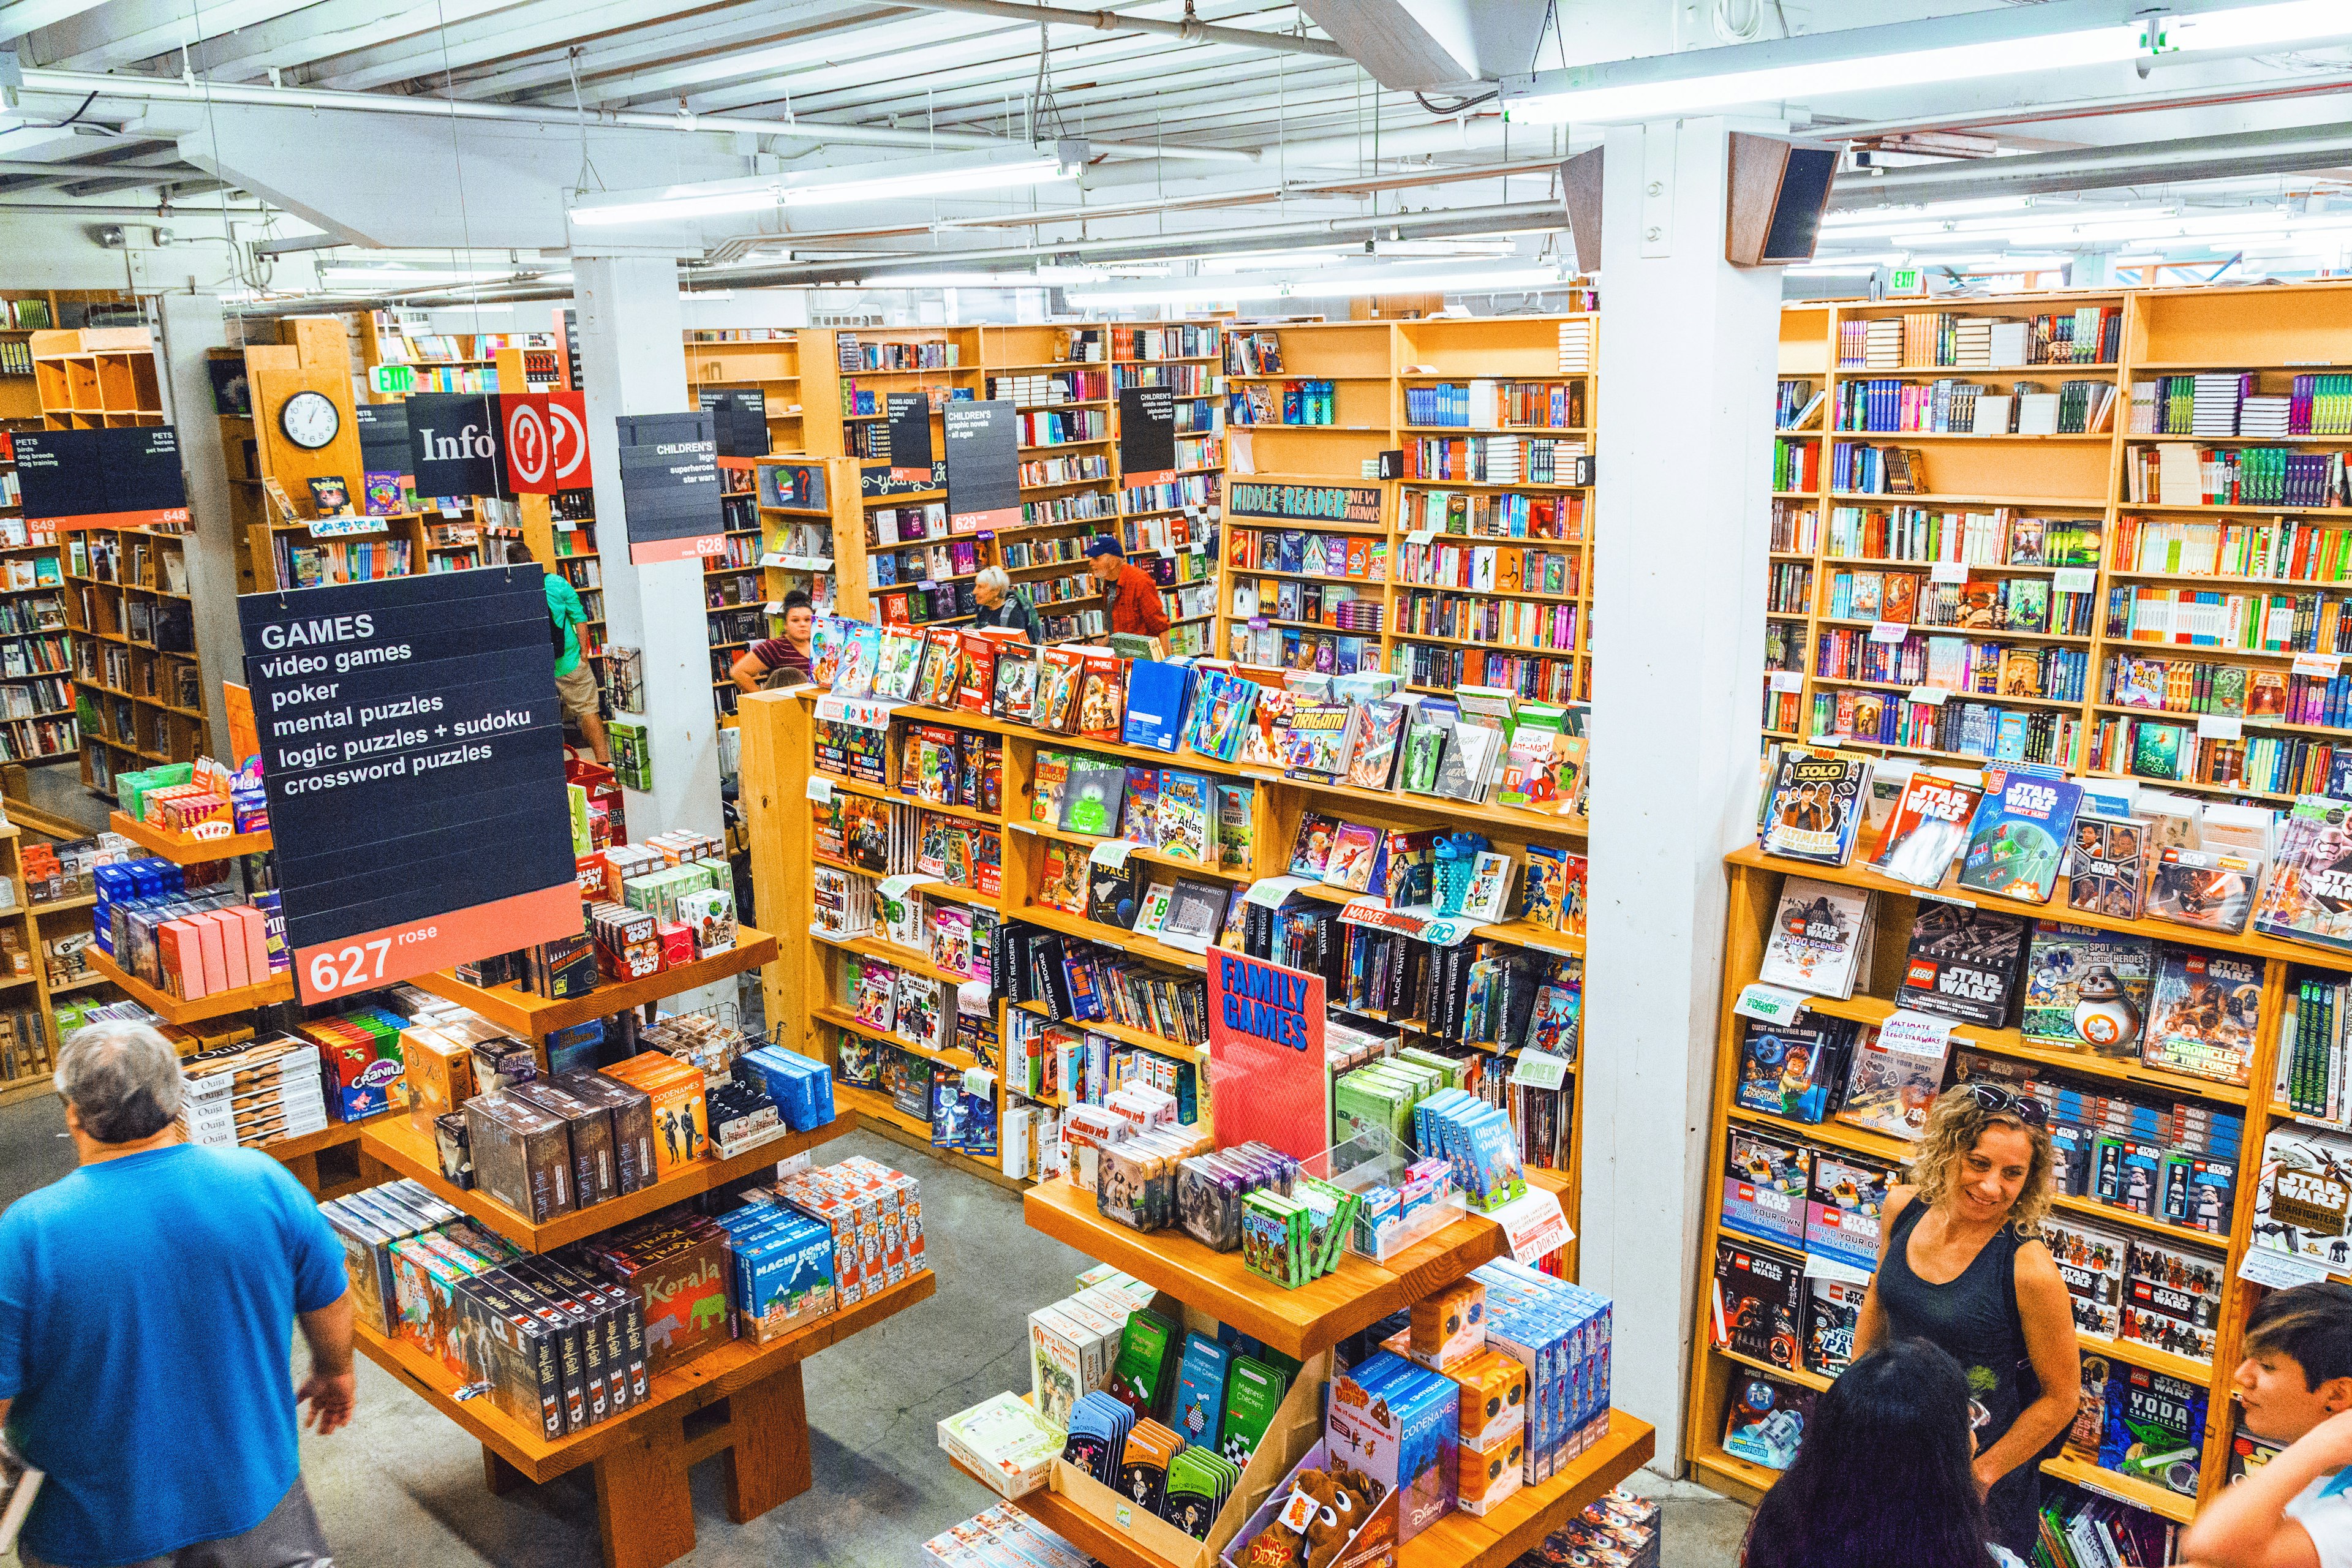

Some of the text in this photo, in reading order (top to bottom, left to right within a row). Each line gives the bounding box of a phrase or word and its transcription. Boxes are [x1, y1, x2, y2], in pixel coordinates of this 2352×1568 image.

[1895, 271, 1916, 288] EXIT
[379, 368, 409, 391] EXIT
[948, 411, 991, 421] CHILDREN'S
[948, 421, 969, 430] graphic
[420, 424, 496, 461] Info
[657, 442, 713, 455] CHILDREN'S
[670, 464, 715, 474] superheroes
[891, 470, 903, 479] 640
[1381, 456, 1390, 477] A
[1577, 459, 1586, 483] B
[1159, 472, 1174, 483] 630
[1232, 484, 1279, 513] MIDDLE
[1350, 489, 1376, 505] NEW
[163, 510, 187, 521] 648
[1344, 505, 1380, 521] ARRIVALS
[31, 520, 55, 531] 649
[956, 516, 976, 530] 629
[696, 538, 723, 554] 628
[262, 614, 375, 649] GAMES
[260, 642, 412, 679] video games
[271, 681, 339, 711] poker
[273, 694, 444, 737] mental puzzles
[1292, 712, 1346, 730] ORIGAMI
[279, 709, 531, 769] logic puzzles sudoku
[1512, 742, 1550, 753] Ant-Man!
[1814, 748, 1835, 761] 1000
[1836, 752, 1864, 761] STICKERS
[284, 742, 492, 795] crossword puzzles
[1072, 760, 1124, 772] UNDERWEAR!
[1799, 765, 1841, 777] SOLO
[1913, 774, 1950, 786] DARTH VADER
[1913, 785, 1969, 809] STAR
[2006, 782, 2059, 799] STAR
[1163, 797, 1196, 821] Animal
[1906, 797, 1968, 822] WARS
[2005, 794, 2056, 811] WARS
[1178, 815, 1203, 834] Atlas
[1224, 815, 1243, 824] MOVIE
[1778, 827, 1834, 845] ULTIMATE
[1104, 845, 1125, 859] NEW
[1097, 863, 1129, 878] SPACE
[2090, 867, 2117, 876] WARS
[2093, 861, 2114, 870] STAR
[2218, 859, 2247, 869] PHONICS
[1200, 885, 1224, 895] ARCHITECT
[1262, 887, 1281, 901] NEW
[1346, 907, 1385, 925] MARVEL
[625, 919, 652, 932] SUSHI
[1431, 925, 1452, 942] DC
[628, 928, 652, 943] GO!
[1790, 934, 1842, 952] 100 SCENES
[1919, 945, 2003, 967] ULTIMATE
[2089, 943, 2109, 953] SPOT
[310, 925, 438, 993] 627 rose
[2082, 953, 2144, 965] GALACTIC HEROES
[1910, 966, 1935, 981] LEGO
[1942, 967, 2002, 987] STAR
[1038, 952, 1060, 1021] CHAPTER BOOKS
[1221, 956, 1309, 1014] FAMILY
[1393, 978, 1401, 1006] BLACK
[1940, 981, 2002, 1003] WARS
[1223, 994, 1308, 1052] GAMES
[1783, 1027, 1799, 1036] KYBER
[195, 1039, 256, 1060] Ouija
[1871, 1053, 1894, 1063] CHOOSE
[2166, 1041, 2241, 1063] CHRONICLES
[1534, 1063, 1560, 1080] NEW
[2163, 1054, 2237, 1075] OF THE FORCE
[200, 1077, 225, 1090] Ouija
[653, 1080, 699, 1103] CODENAMES
[665, 1093, 690, 1105] PICTURES
[1069, 1116, 1109, 1140] slamwich
[1475, 1125, 1501, 1140] Okey
[1479, 1133, 1511, 1153] Dokey
[1725, 1199, 1800, 1227] BUILD YOUR OWN
[1736, 1210, 1788, 1231] ADVENTURE
[2275, 1201, 2342, 1225] STARFIGHTERS
[1253, 1215, 1281, 1232] STORY
[756, 1239, 830, 1276] MACHI KORO
[1517, 1232, 1560, 1265] OKEY DOKEY
[643, 1257, 720, 1306] Kerala
[1055, 1335, 1076, 1357] Upon
[1052, 1345, 1077, 1373] Time
[1238, 1382, 1265, 1400] Magnetic
[1236, 1391, 1264, 1410] Checkers
[2131, 1392, 2187, 1422] YODA
[547, 1393, 557, 1431] CLUE
[1402, 1400, 1458, 1439] CODENAMES
[2130, 1408, 2187, 1431] CHRONICLES
[1261, 1534, 1281, 1552] WHO
